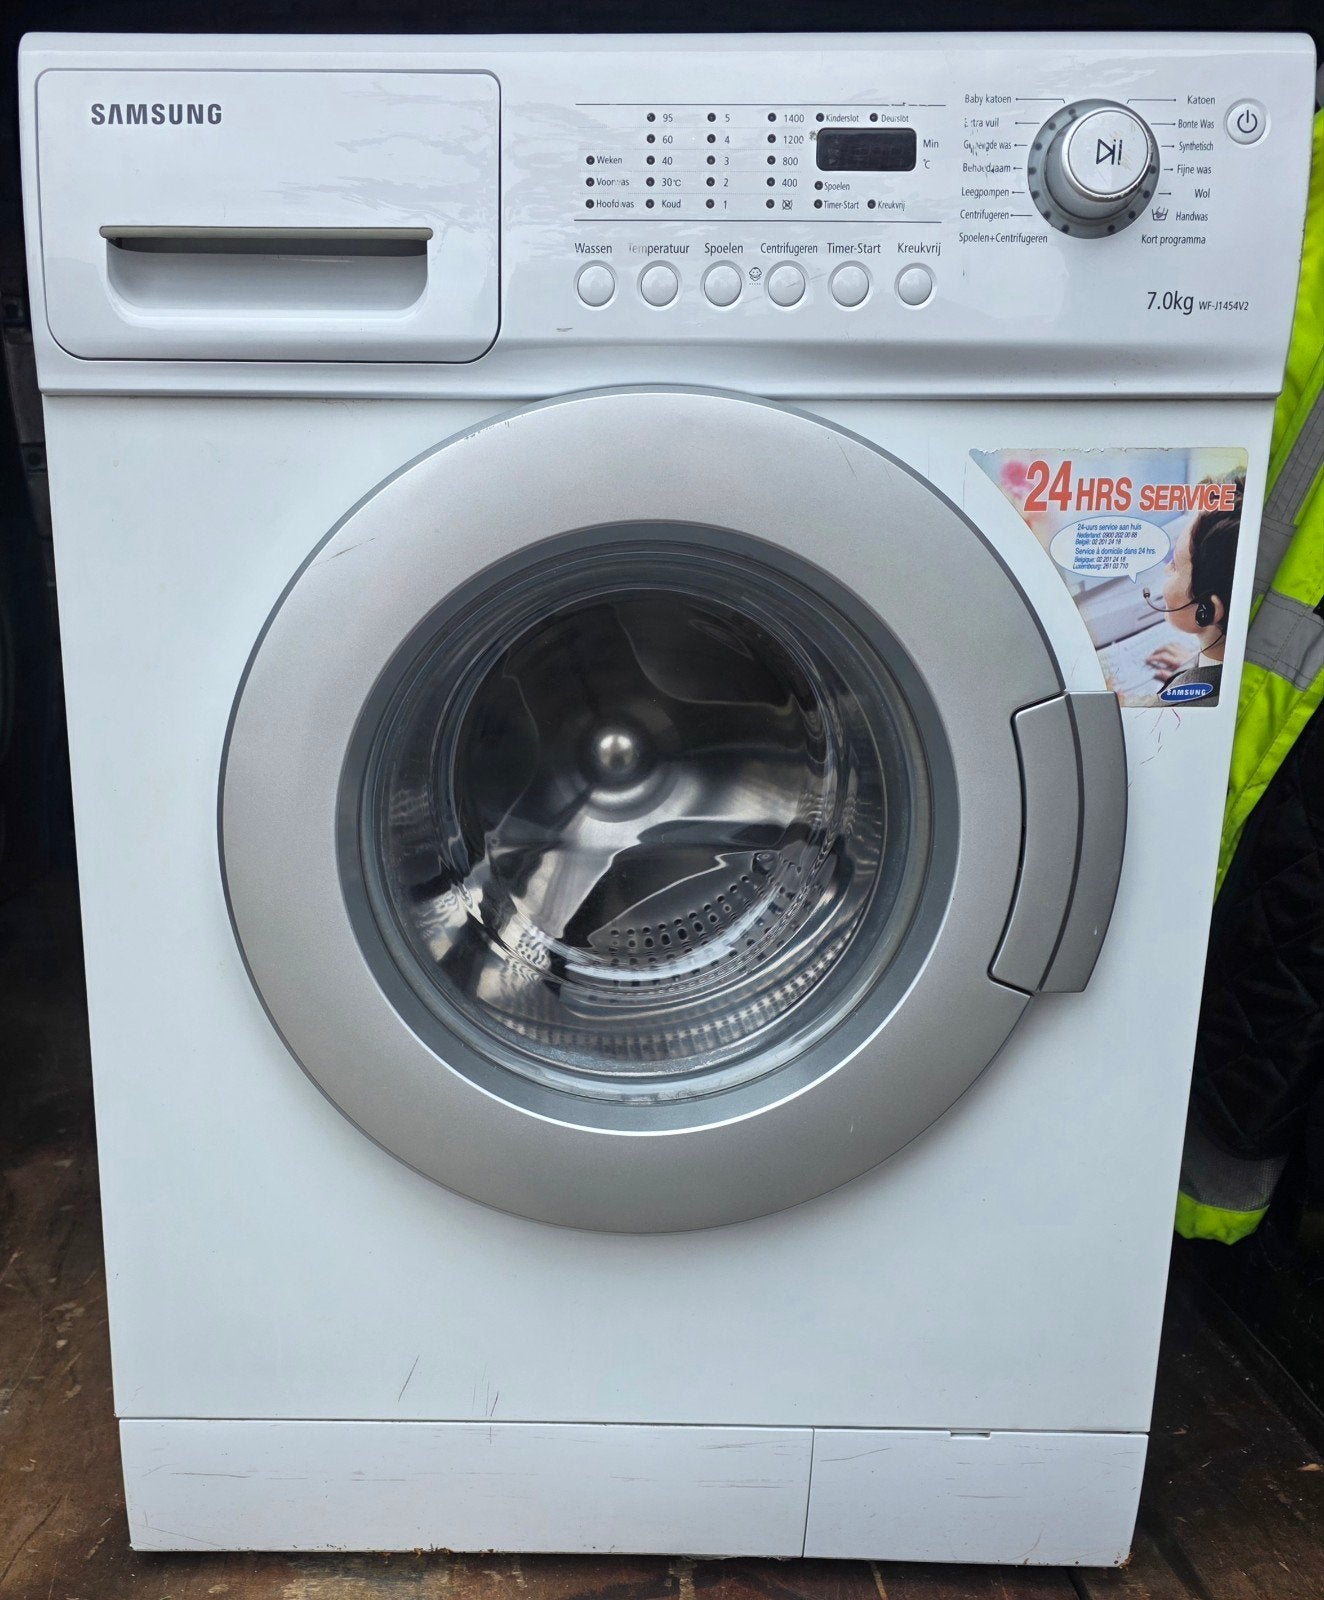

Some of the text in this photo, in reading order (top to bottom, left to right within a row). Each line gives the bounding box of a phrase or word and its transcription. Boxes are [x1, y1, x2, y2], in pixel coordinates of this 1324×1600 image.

[965, 94, 1012, 105] Baby katoen
[1187, 96, 1216, 105] Katoen
[91, 103, 222, 125] SAMSUNG
[662, 113, 673, 122] 95
[725, 114, 730, 122] 5
[784, 114, 805, 123] 1400
[826, 114, 859, 123] Kinderslot
[986, 118, 999, 128] vuil
[1178, 119, 1215, 128] Bonte Was
[662, 136, 673, 144] 60
[724, 136, 730, 144] 4
[783, 136, 804, 144] 1200
[923, 139, 939, 148] Min
[1179, 141, 1214, 152] Synthetisch
[596, 156, 623, 165] Weken
[662, 156, 673, 165] 40
[724, 157, 730, 165] 3
[782, 157, 798, 165] 800
[1177, 165, 1212, 176] Fijne was
[723, 178, 729, 187] 2
[782, 178, 798, 187] 400
[824, 182, 850, 191] Spoelen
[961, 187, 1010, 198] Leegpompen
[1194, 189, 1210, 198] Wol
[662, 199, 681, 208] Koud
[824, 200, 859, 209] Timer-Start
[878, 200, 906, 211] Kreukvrij
[960, 210, 1010, 222] Centrifugeren
[1175, 212, 1208, 221] Handwas
[959, 232, 1048, 244] Spoelen+Centrifugeren
[1141, 234, 1206, 246] Kort programma
[574, 243, 613, 254] Wassen
[627, 243, 690, 256] Temperatuur
[704, 243, 744, 256] Spoelen
[760, 243, 818, 256] Centrifugeren
[827, 242, 881, 254] Timer-Start
[897, 242, 942, 257] Kreukvrij
[1147, 291, 1249, 315] 7.0kg WF-J1454V2
[1023, 460, 1236, 512] 24 HRS SERVICE
[1166, 688, 1206, 696] SAMSUNG
